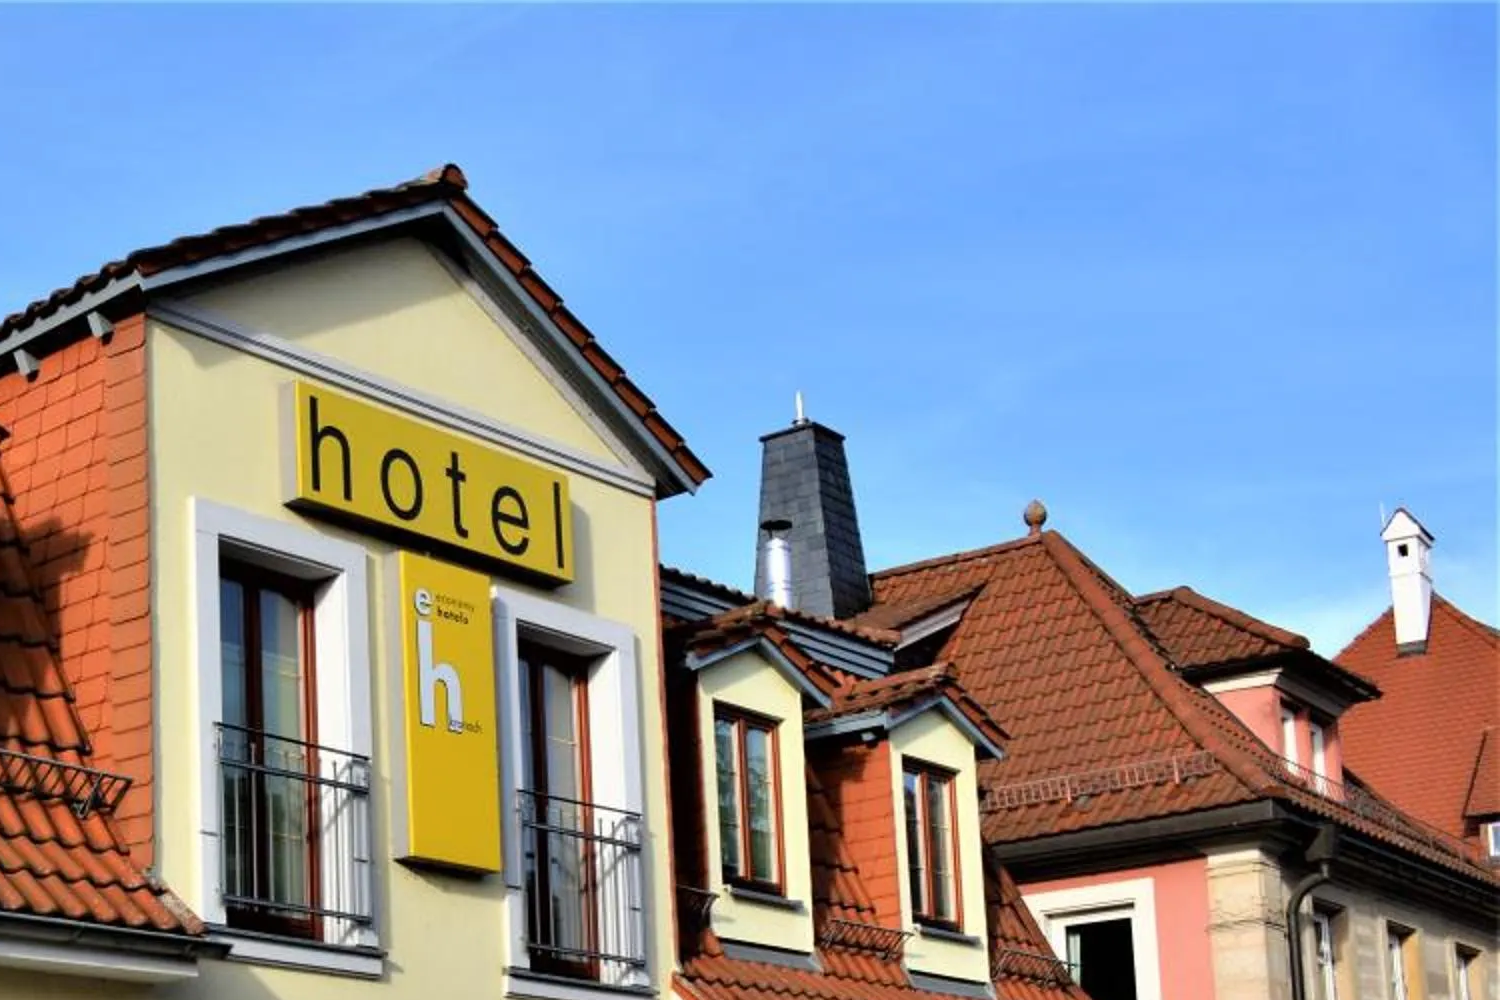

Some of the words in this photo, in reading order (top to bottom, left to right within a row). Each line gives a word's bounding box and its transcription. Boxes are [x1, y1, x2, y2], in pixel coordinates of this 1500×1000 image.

[309, 395, 565, 569] hotel
[414, 587, 433, 615] e
[416, 619, 464, 734] h
